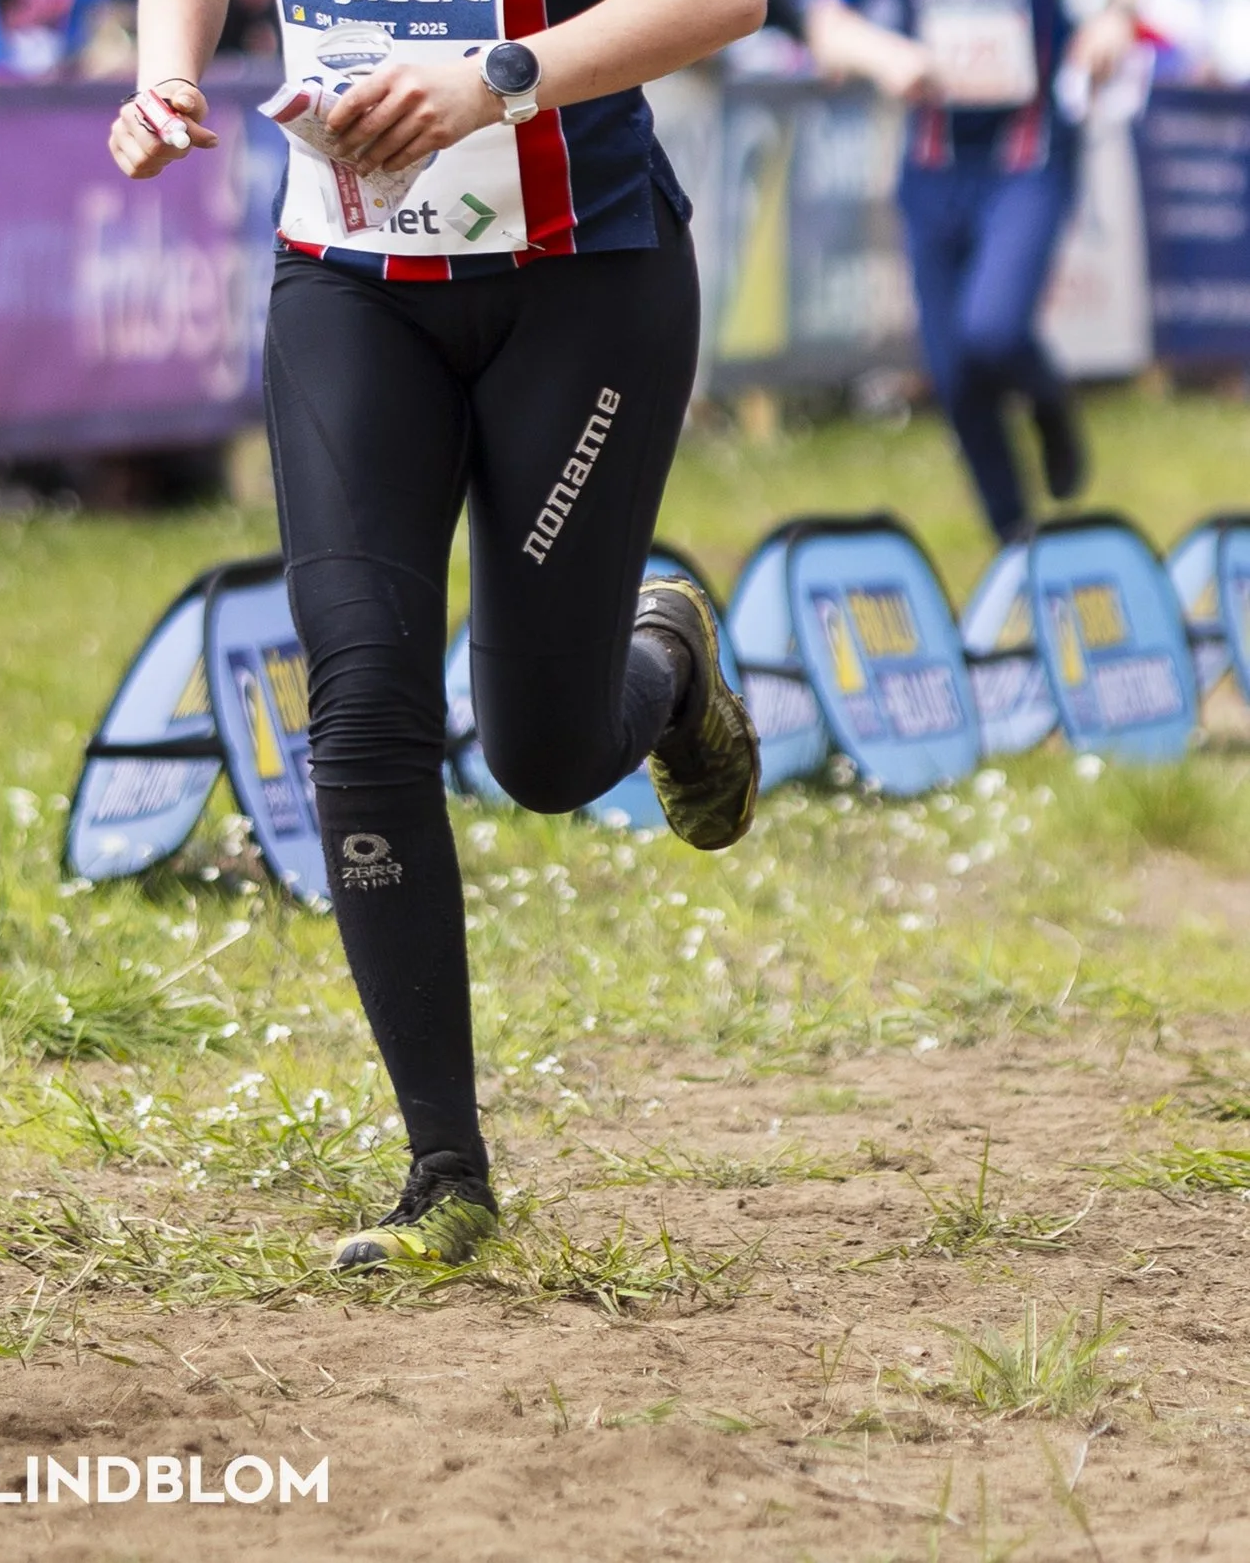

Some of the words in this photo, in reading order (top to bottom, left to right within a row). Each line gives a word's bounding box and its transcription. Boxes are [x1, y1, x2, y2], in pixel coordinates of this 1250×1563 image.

[315, 12, 333, 28] SM
[409, 21, 449, 36] 2025
[522, 386, 621, 565] noname
